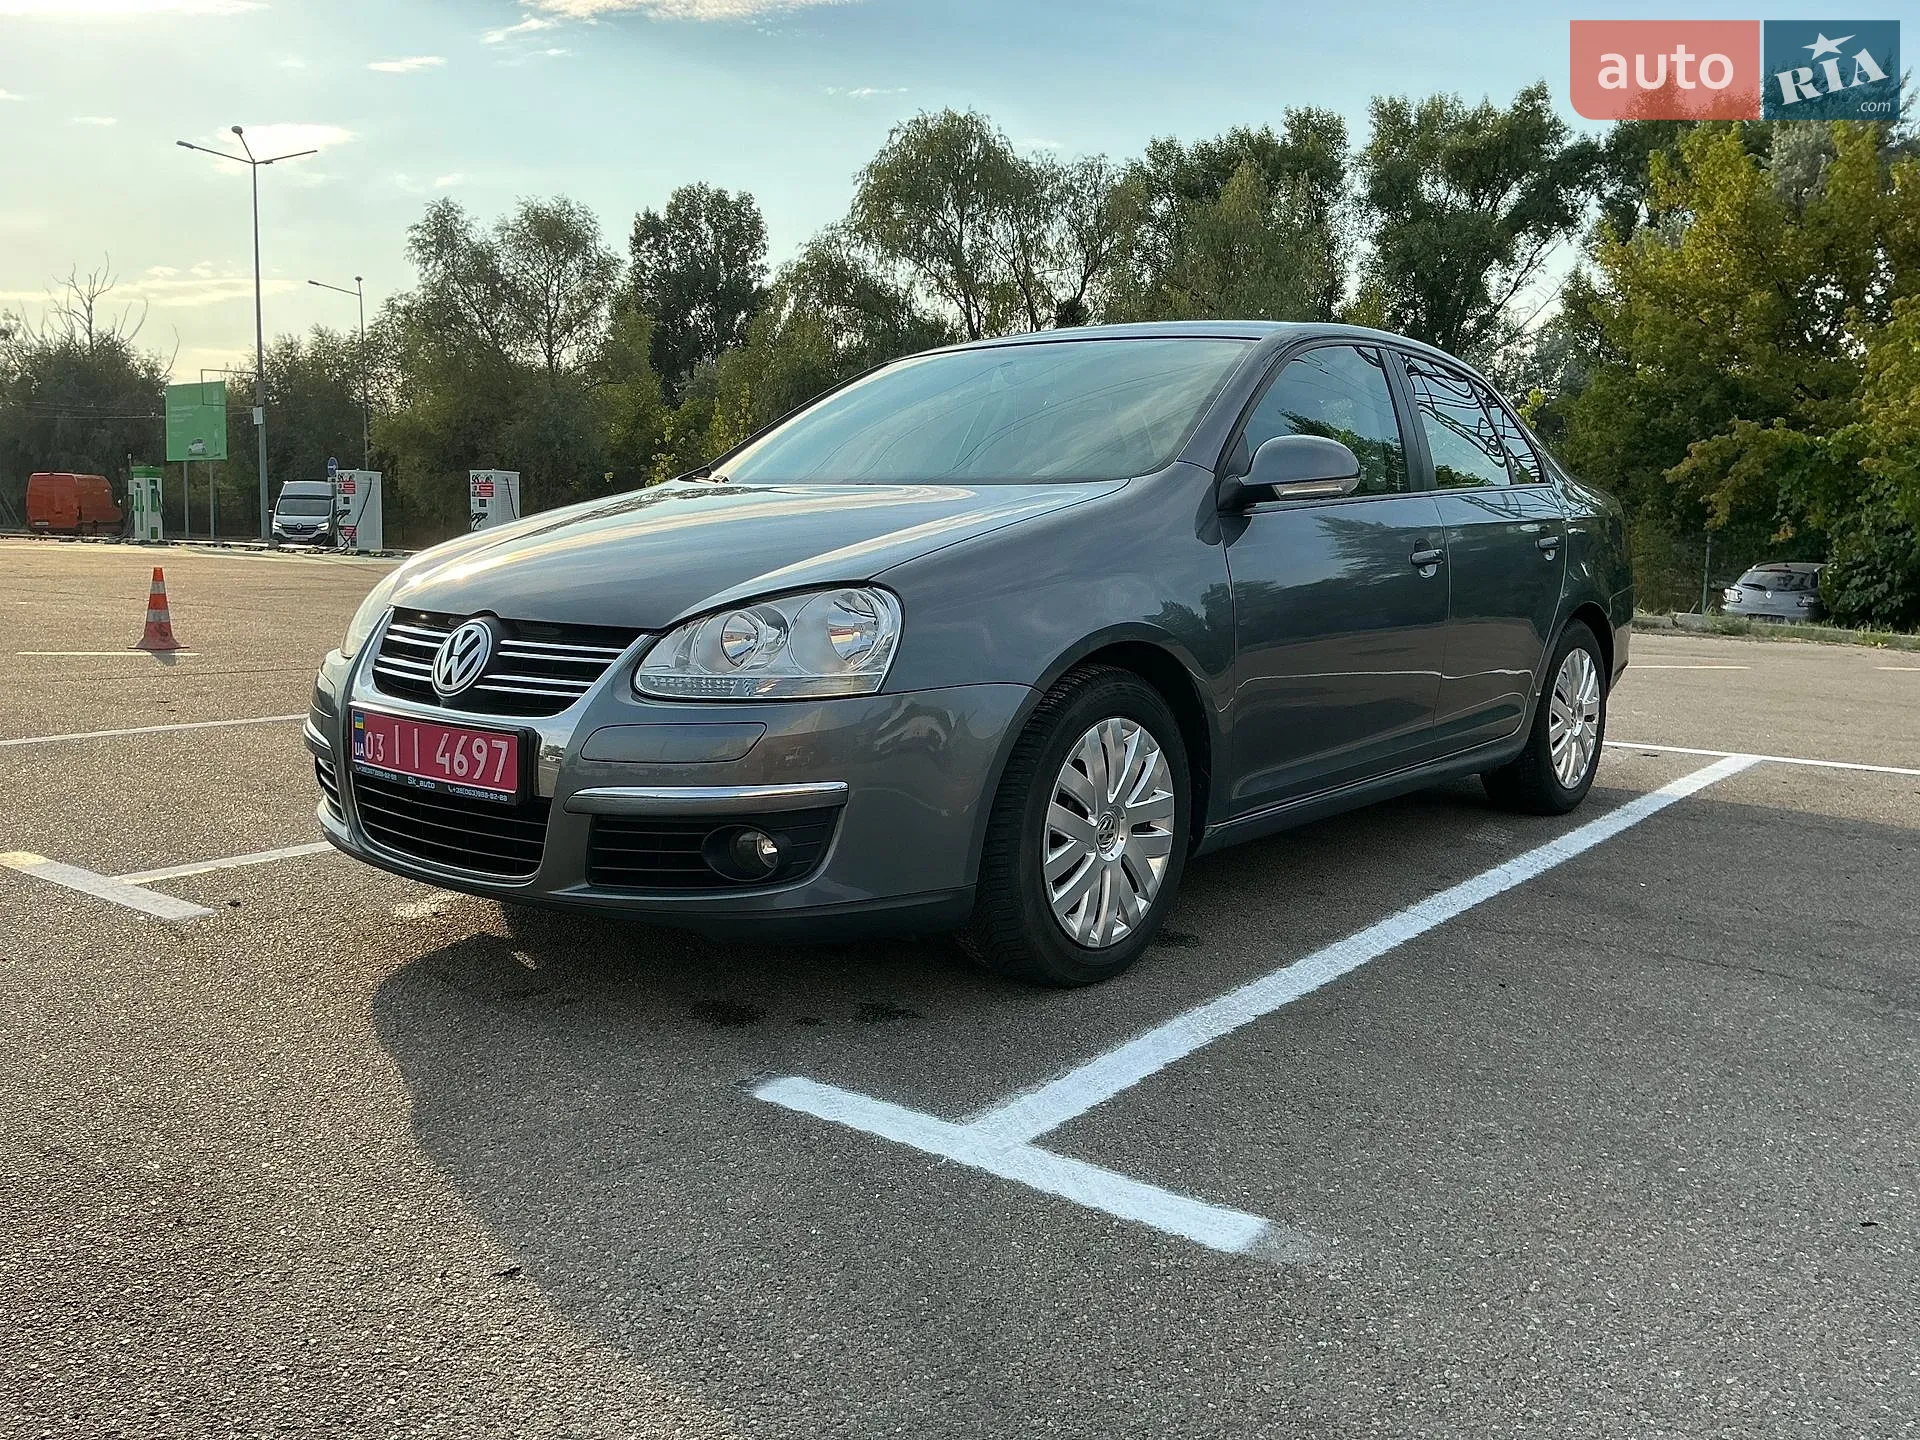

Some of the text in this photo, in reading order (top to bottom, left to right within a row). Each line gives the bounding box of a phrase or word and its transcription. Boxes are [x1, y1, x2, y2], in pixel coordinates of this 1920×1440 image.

[354, 742, 365, 757] UA
[365, 731, 385, 762] 03
[435, 733, 509, 783] 4697
